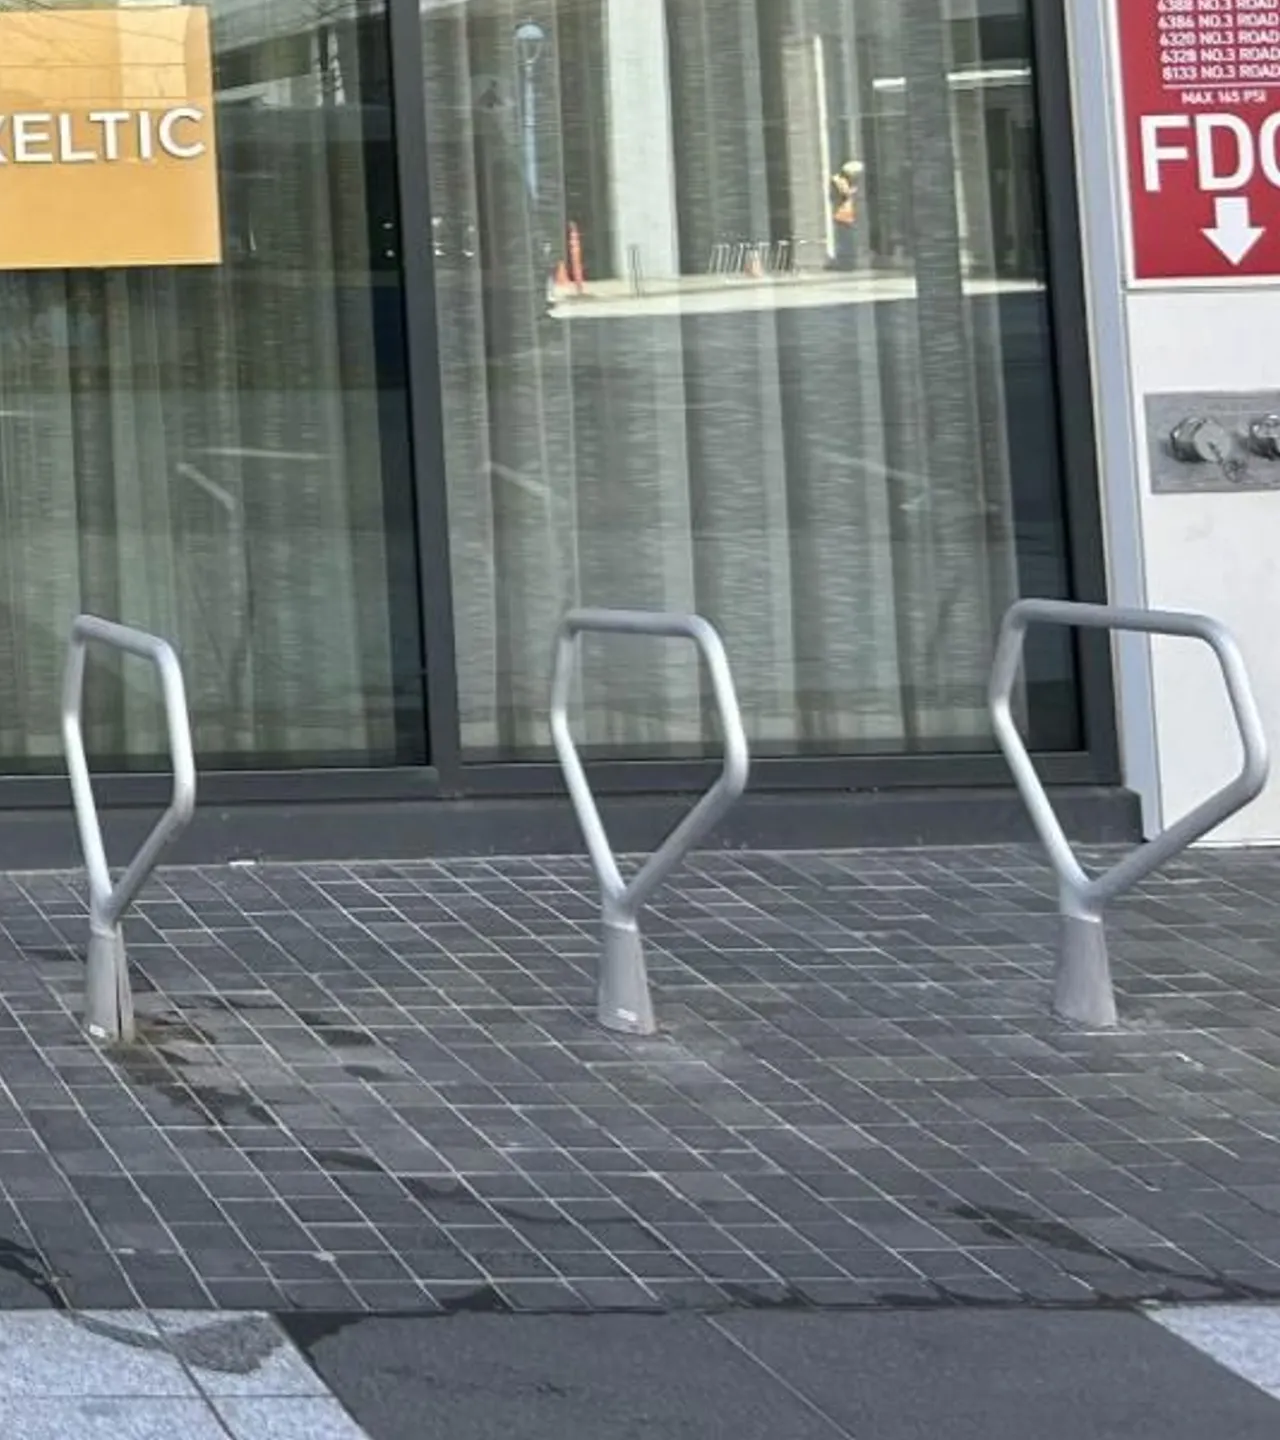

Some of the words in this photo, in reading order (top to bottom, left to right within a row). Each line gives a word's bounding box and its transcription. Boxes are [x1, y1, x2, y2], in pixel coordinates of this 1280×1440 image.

[1198, 13, 1233, 27] NO.3
[1237, 11, 1279, 26] ROAD
[1199, 30, 1234, 44] NO.3
[1238, 29, 1280, 43] ROAD
[1200, 47, 1235, 61] NO.3
[1239, 46, 1280, 60] ROAD
[1200, 63, 1236, 78] NO.3
[1239, 62, 1280, 78] ROAD
